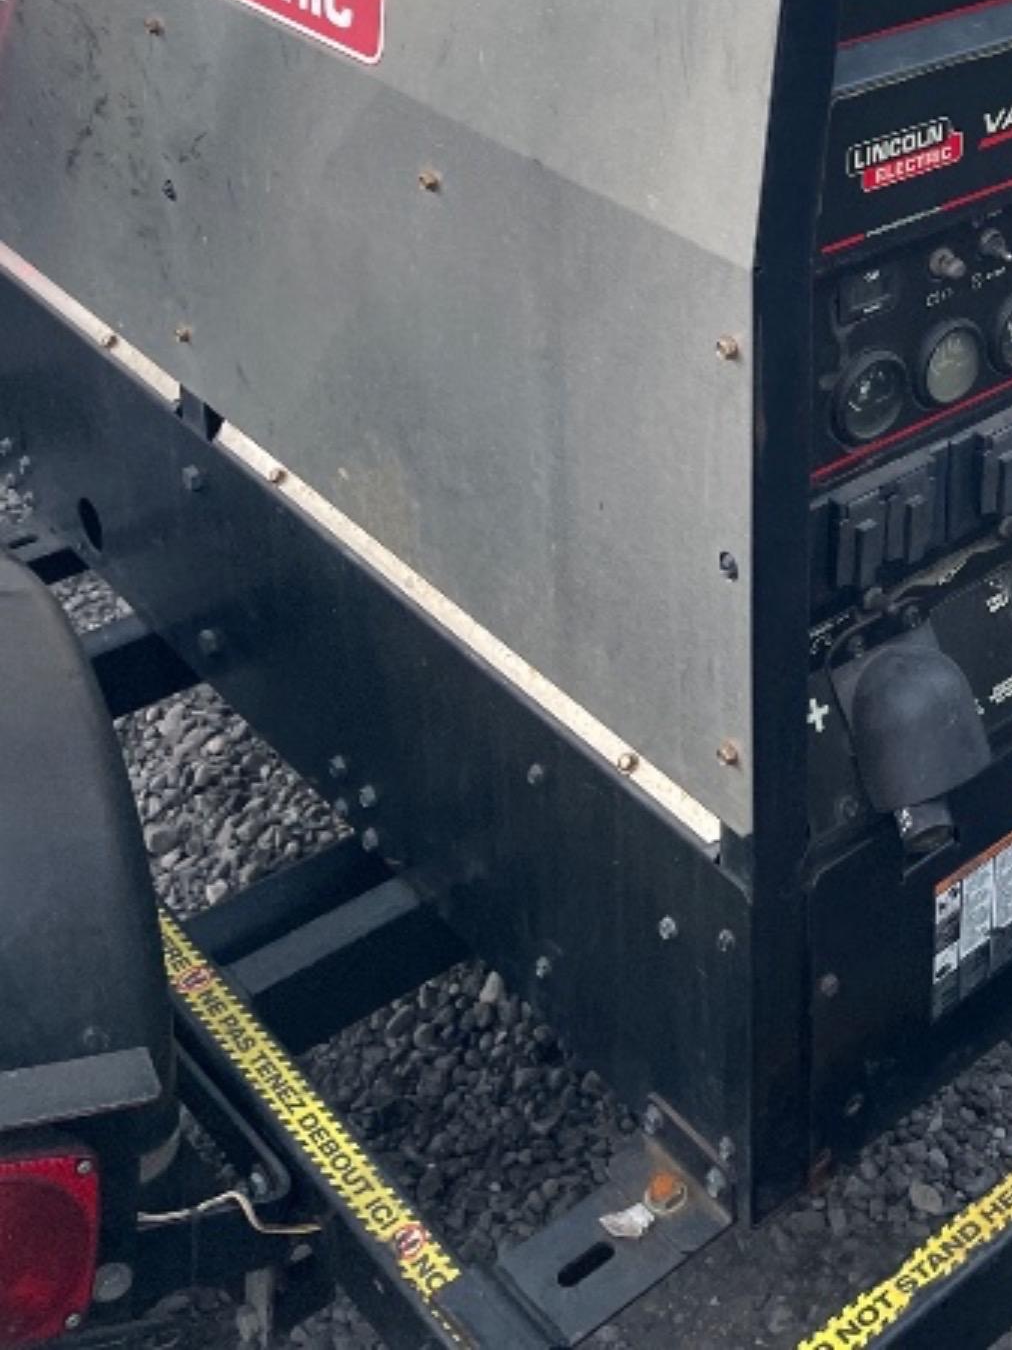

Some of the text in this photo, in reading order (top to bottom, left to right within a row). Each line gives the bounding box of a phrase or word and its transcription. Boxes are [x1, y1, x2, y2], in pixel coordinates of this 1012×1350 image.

[854, 123, 943, 169] LINCOLN
[875, 146, 952, 184] ELECTRIC
[201, 992, 228, 1019] NE
[220, 1012, 256, 1053] PAS
[253, 1050, 306, 1118] TENEZ
[298, 1114, 376, 1200] DEBOUT
[367, 1196, 401, 1233] ICI
[837, 1290, 894, 1344] NOT
[896, 1220, 983, 1295] STAND
